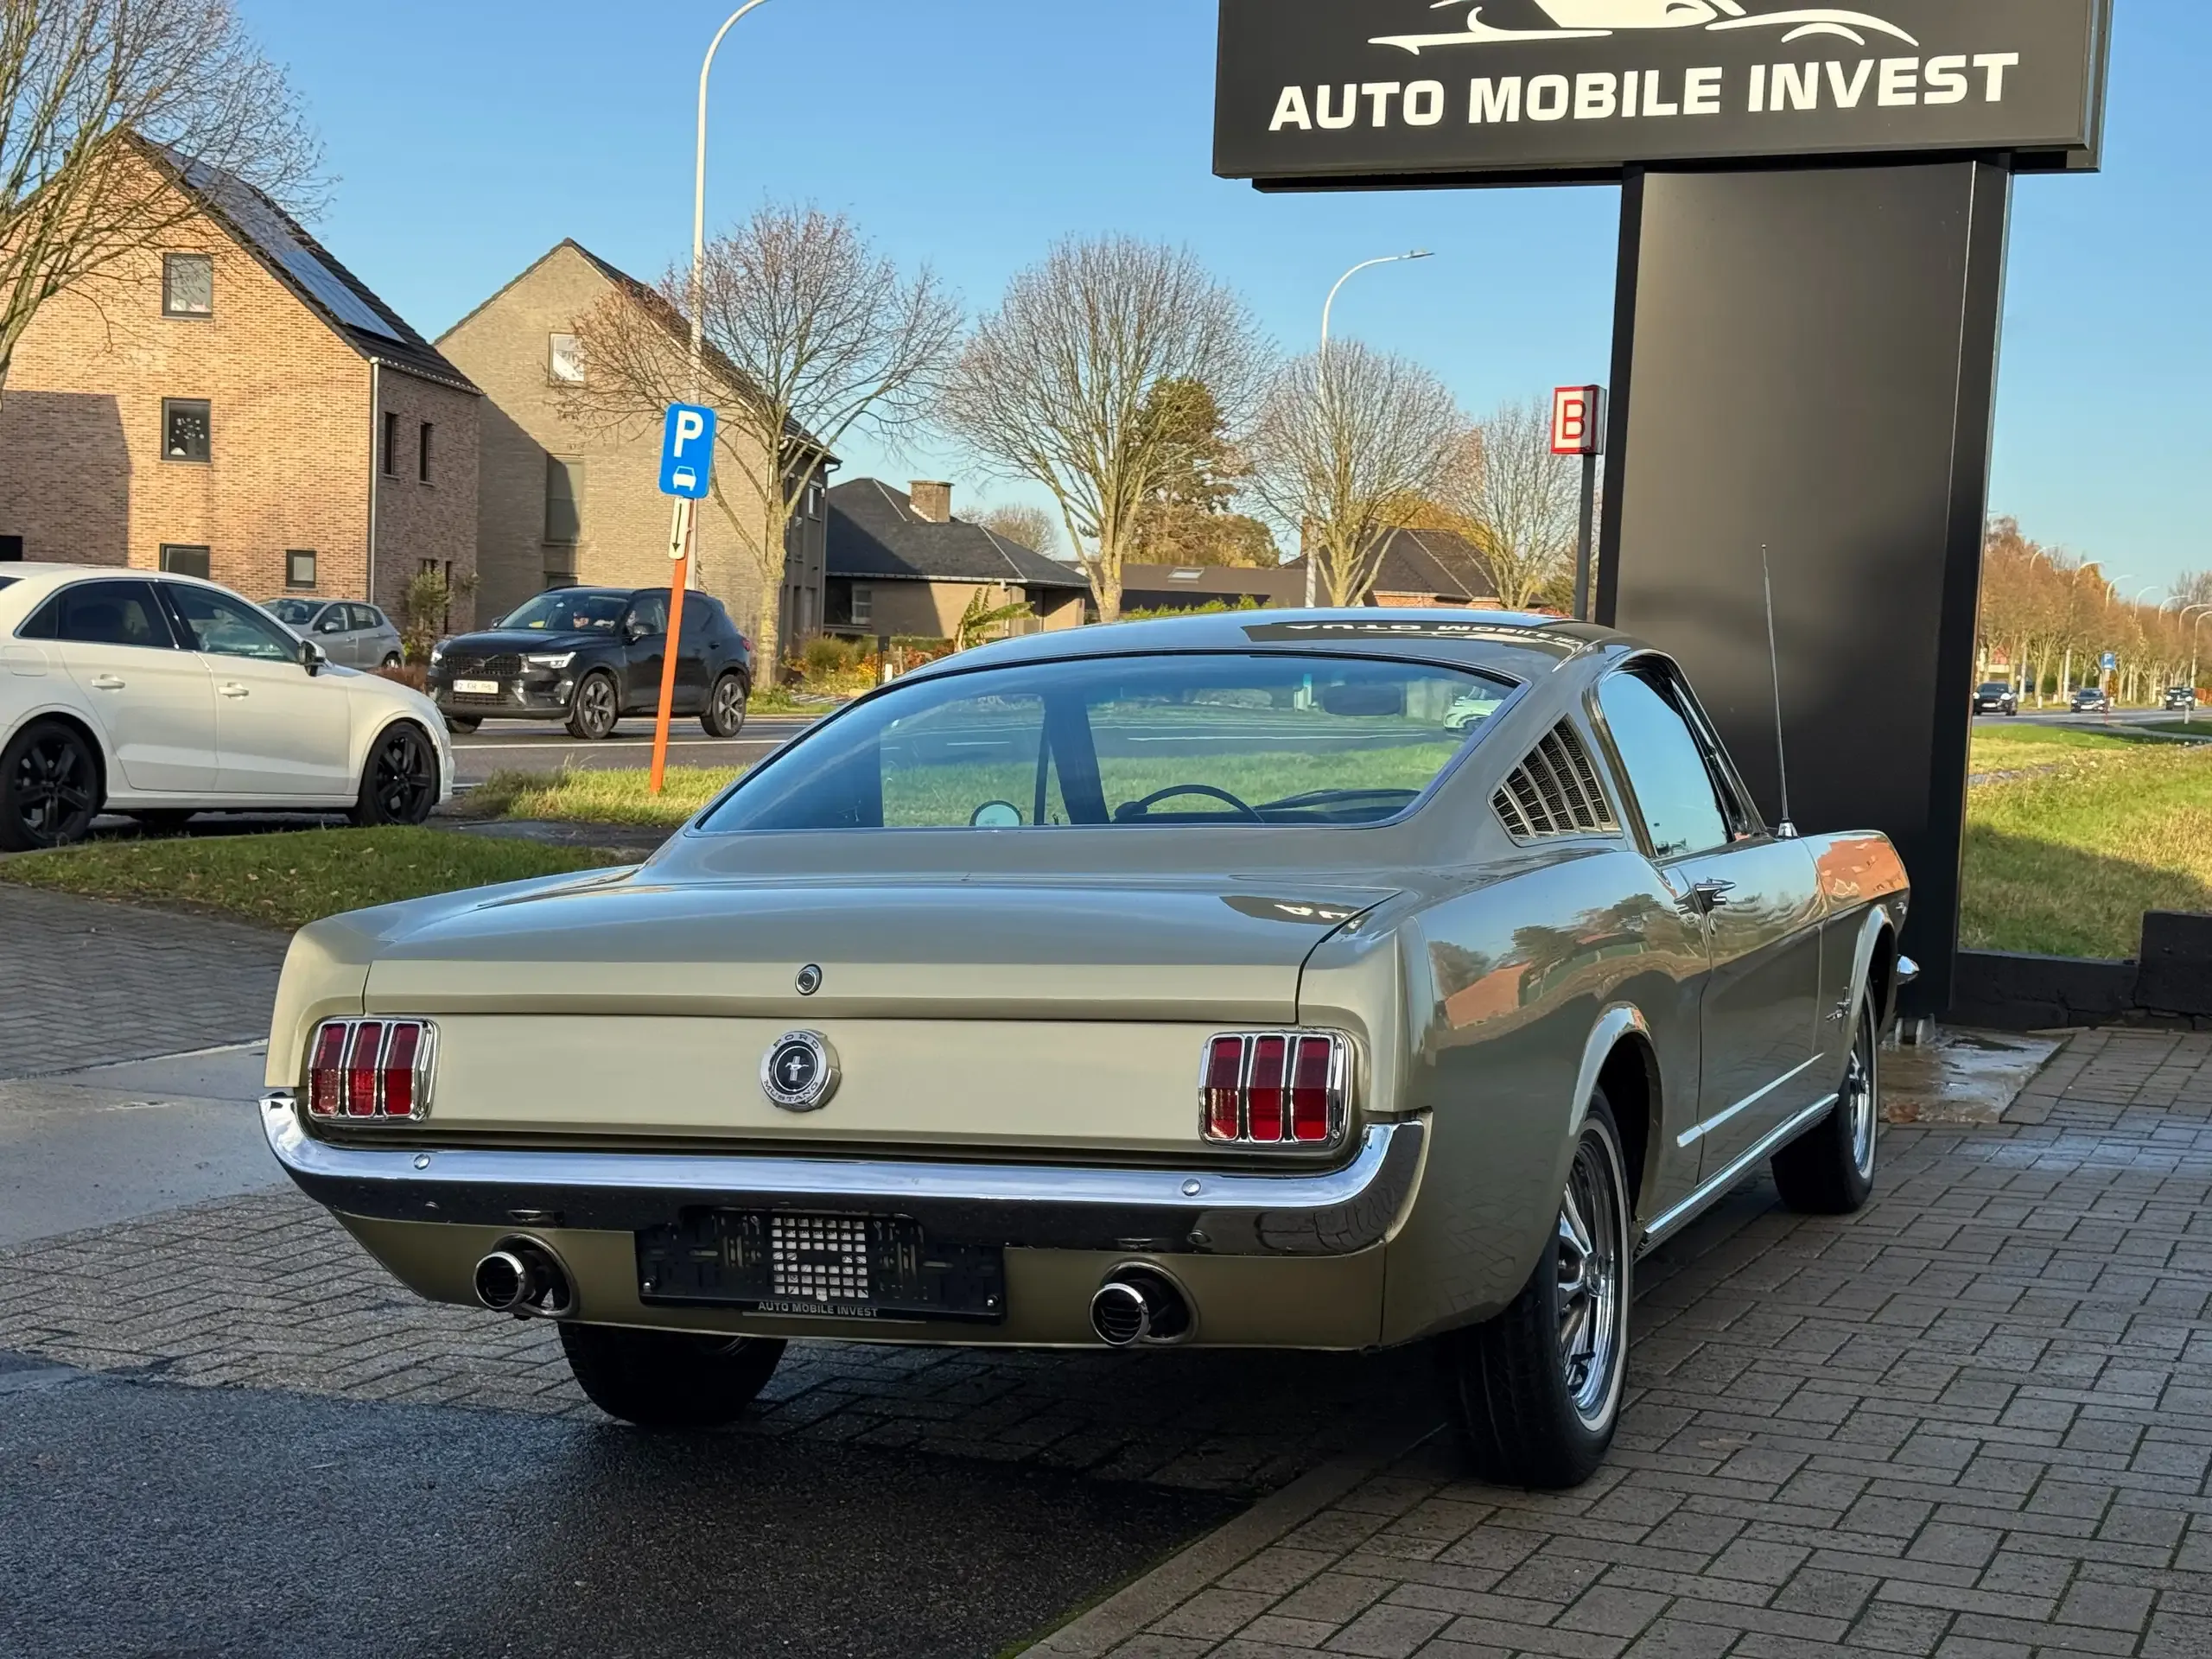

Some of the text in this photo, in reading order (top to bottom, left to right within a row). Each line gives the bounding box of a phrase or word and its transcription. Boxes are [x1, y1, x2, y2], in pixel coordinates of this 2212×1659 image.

[1268, 52, 2019, 131] AUTO MOBILE INVEST
[673, 410, 703, 457] P
[1562, 399, 1586, 439] B
[773, 1033, 819, 1050] FORD
[763, 1079, 819, 1103] MUSTANG
[758, 1301, 878, 1317] AUTO MOBILE INVEST
